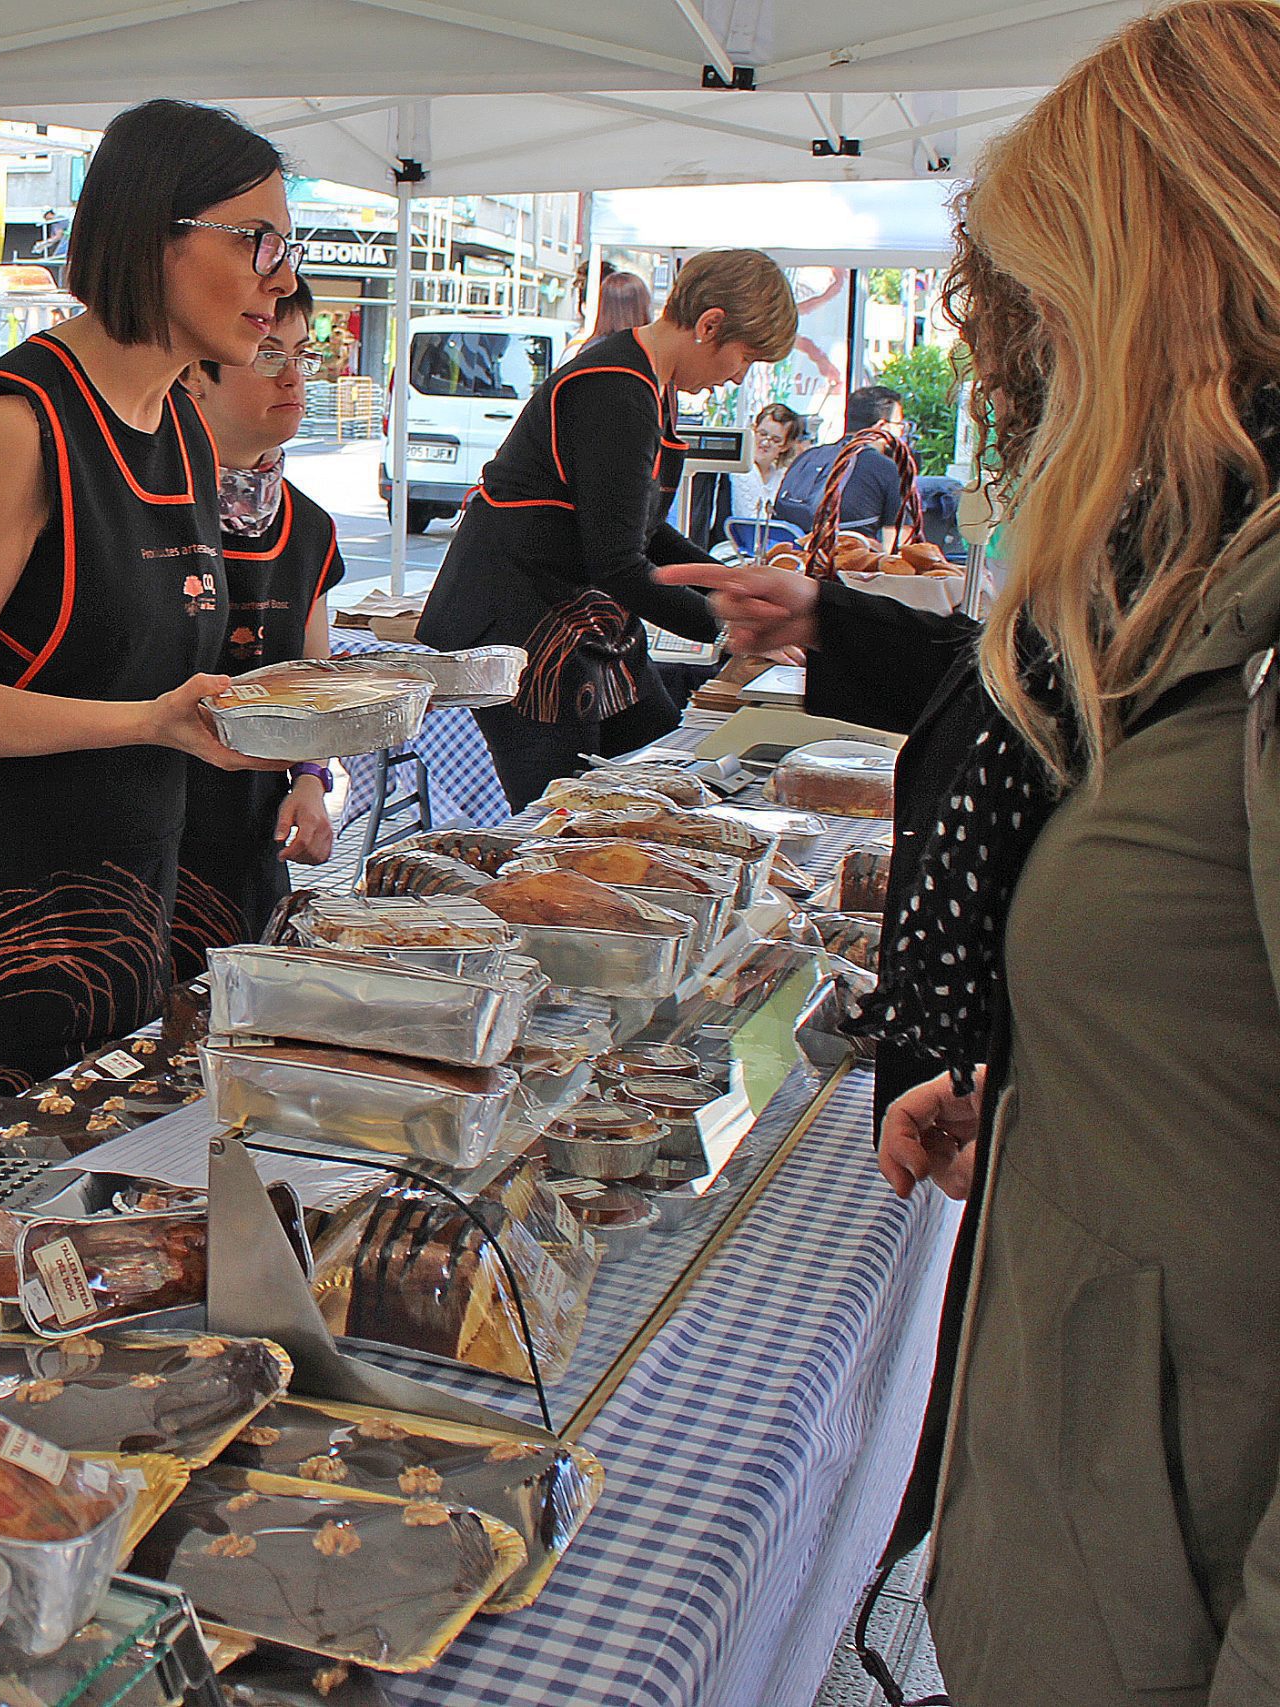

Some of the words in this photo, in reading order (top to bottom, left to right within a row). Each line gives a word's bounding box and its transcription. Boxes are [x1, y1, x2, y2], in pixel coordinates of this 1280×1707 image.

[60, 1243, 78, 1275] TALLER
[55, 1259, 67, 1277] DEL
[62, 1276, 77, 1303] BOSC
